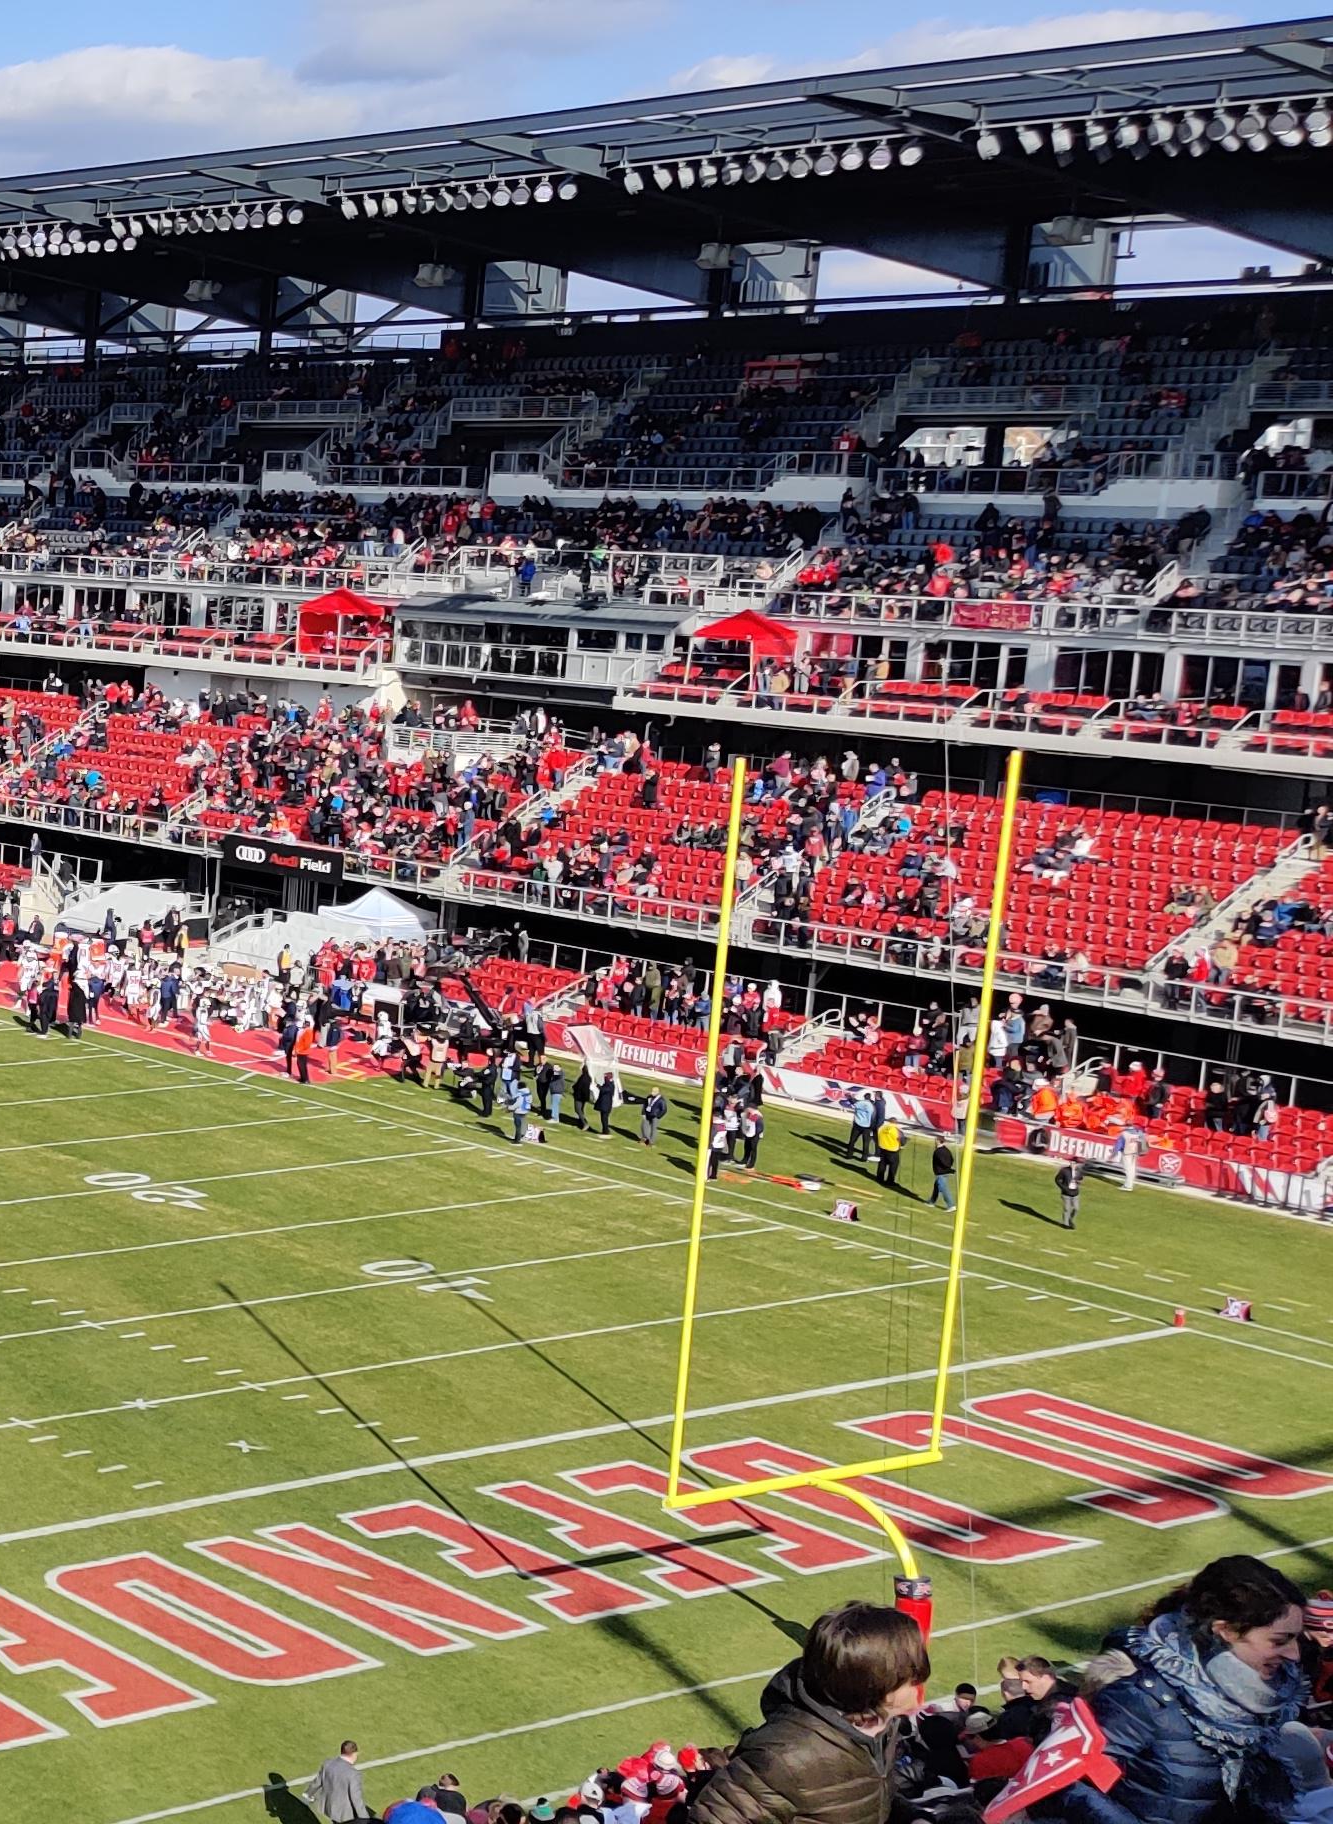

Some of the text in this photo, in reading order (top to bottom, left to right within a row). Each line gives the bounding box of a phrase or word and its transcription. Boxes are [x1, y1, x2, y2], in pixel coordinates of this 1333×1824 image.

[269, 852, 332, 874] Audi Field
[613, 1039, 678, 1070] DEFENDERS
[1049, 1130, 1123, 1163] DEFENDE
[84, 1171, 201, 1204] 20
[360, 1258, 491, 1295] 10
[833, 1388, 1333, 1530] DC
